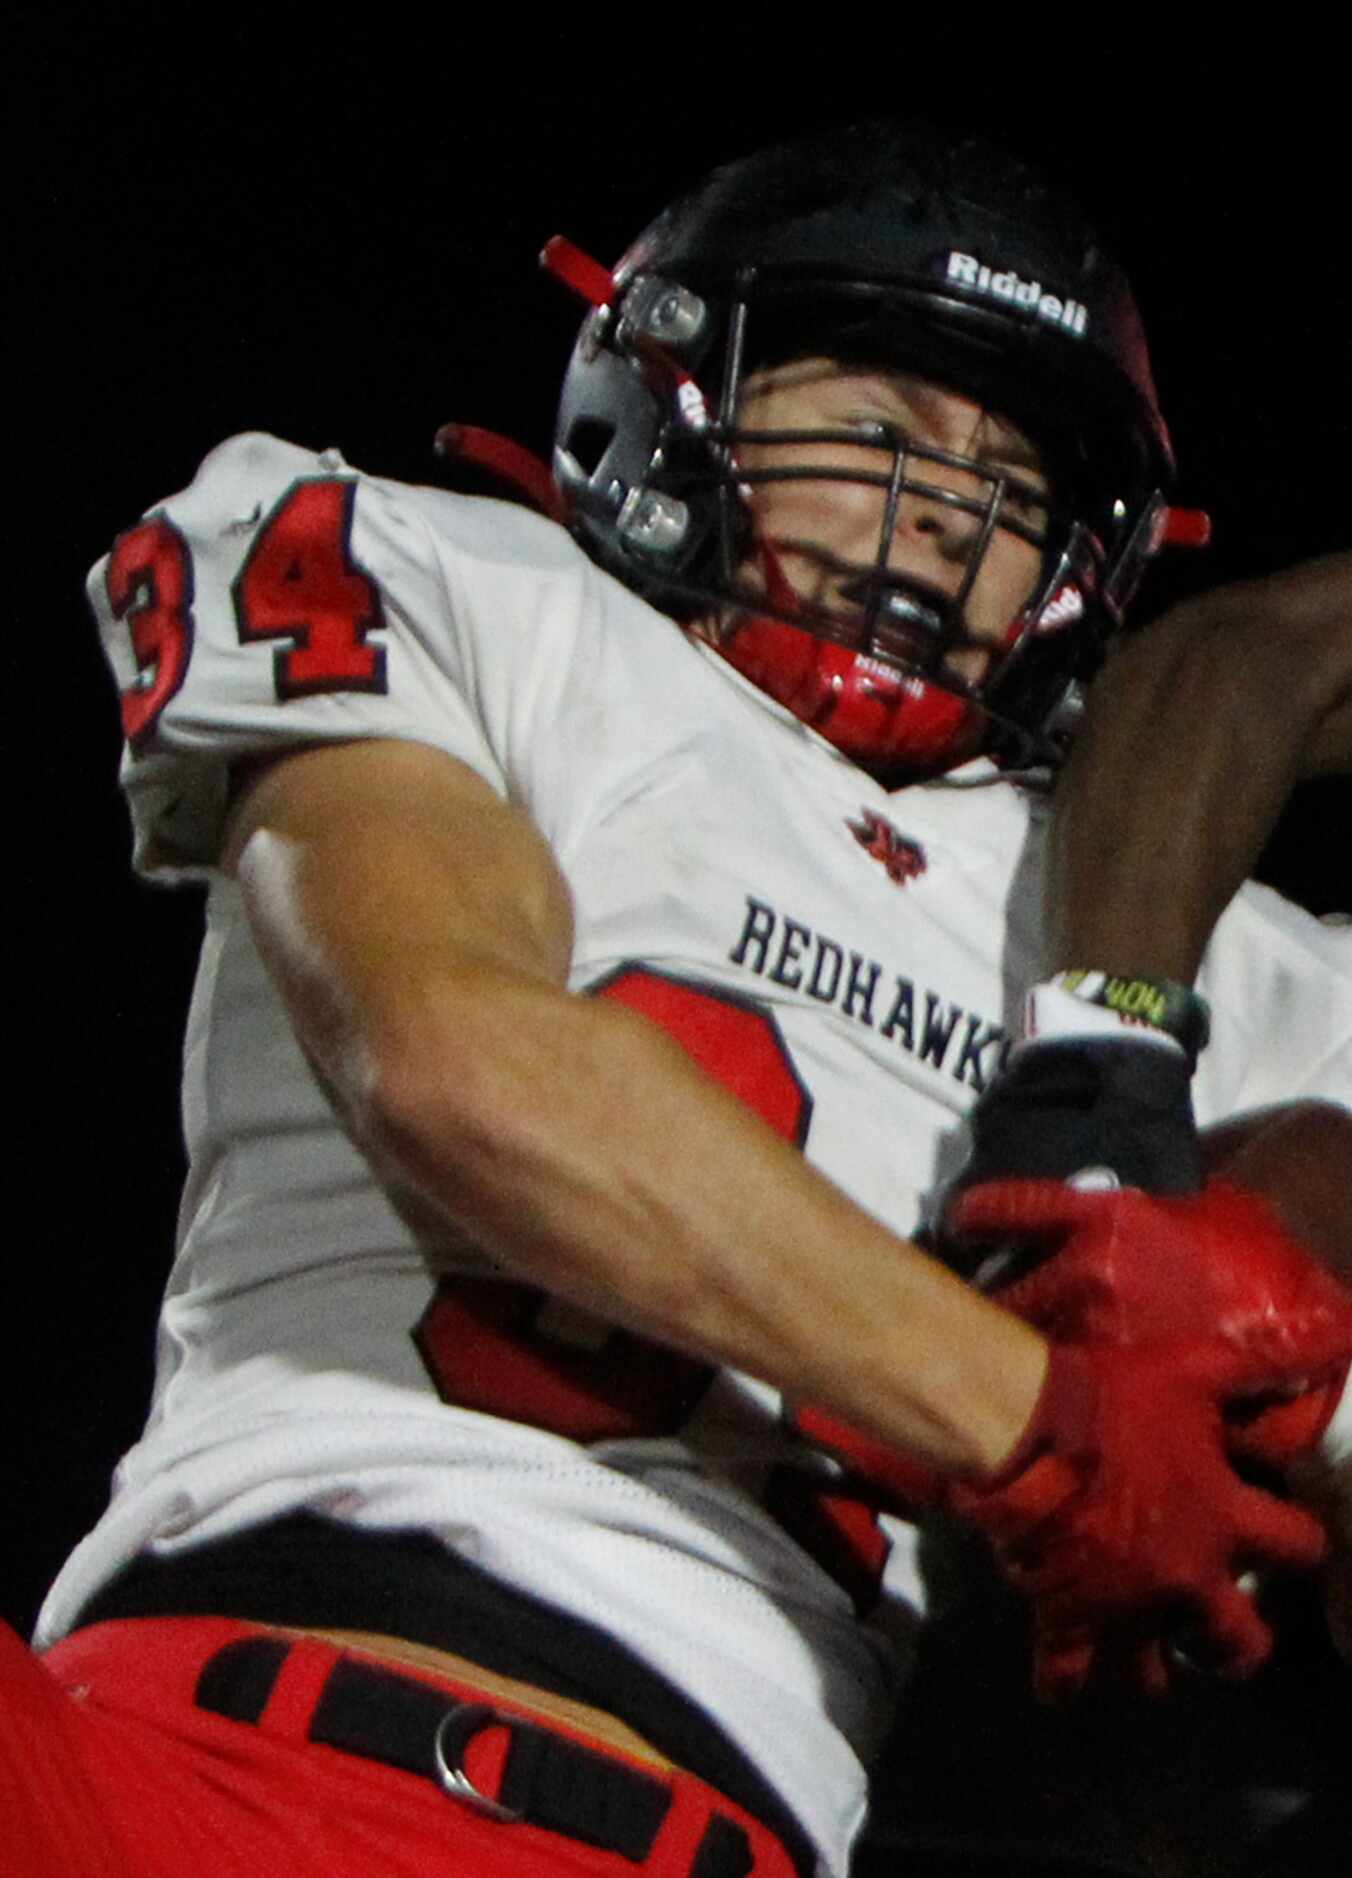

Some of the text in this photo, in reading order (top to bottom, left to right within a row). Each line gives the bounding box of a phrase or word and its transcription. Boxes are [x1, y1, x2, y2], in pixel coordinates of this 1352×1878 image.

[946, 250, 1089, 336] Riddell
[106, 475, 388, 746] 34
[730, 896, 1011, 1092] REDHAWK
